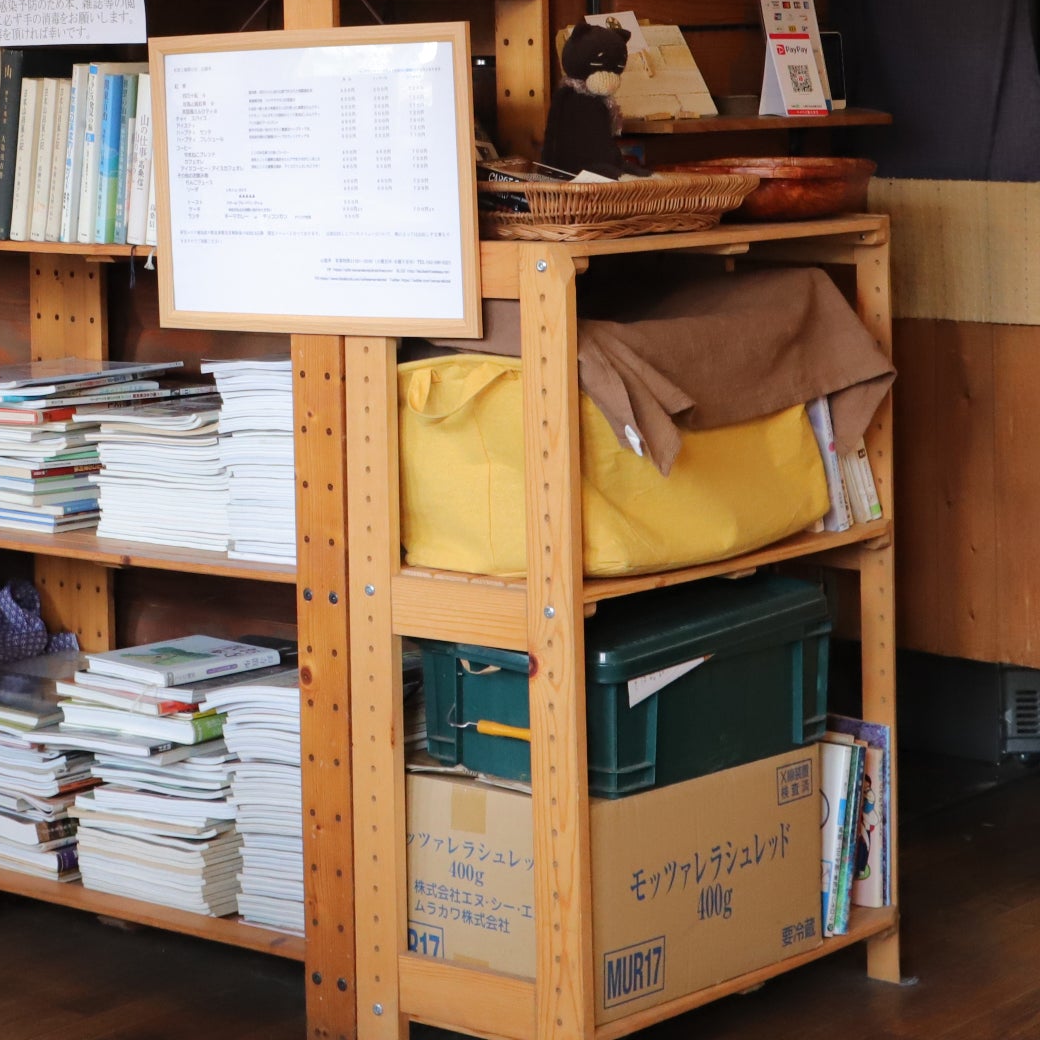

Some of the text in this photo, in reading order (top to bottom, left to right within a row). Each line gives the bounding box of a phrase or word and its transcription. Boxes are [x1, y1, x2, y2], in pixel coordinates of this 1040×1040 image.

[785, 46, 808, 55] PayPay
[449, 861, 484, 888] 400g
[631, 822, 791, 901] モッツァレラシュレッド
[414, 900, 511, 935] ムラカワ株式会社
[697, 883, 733, 920] 400g
[781, 917, 816, 948] 要冷蔵
[607, 947, 662, 1000] MUR17
